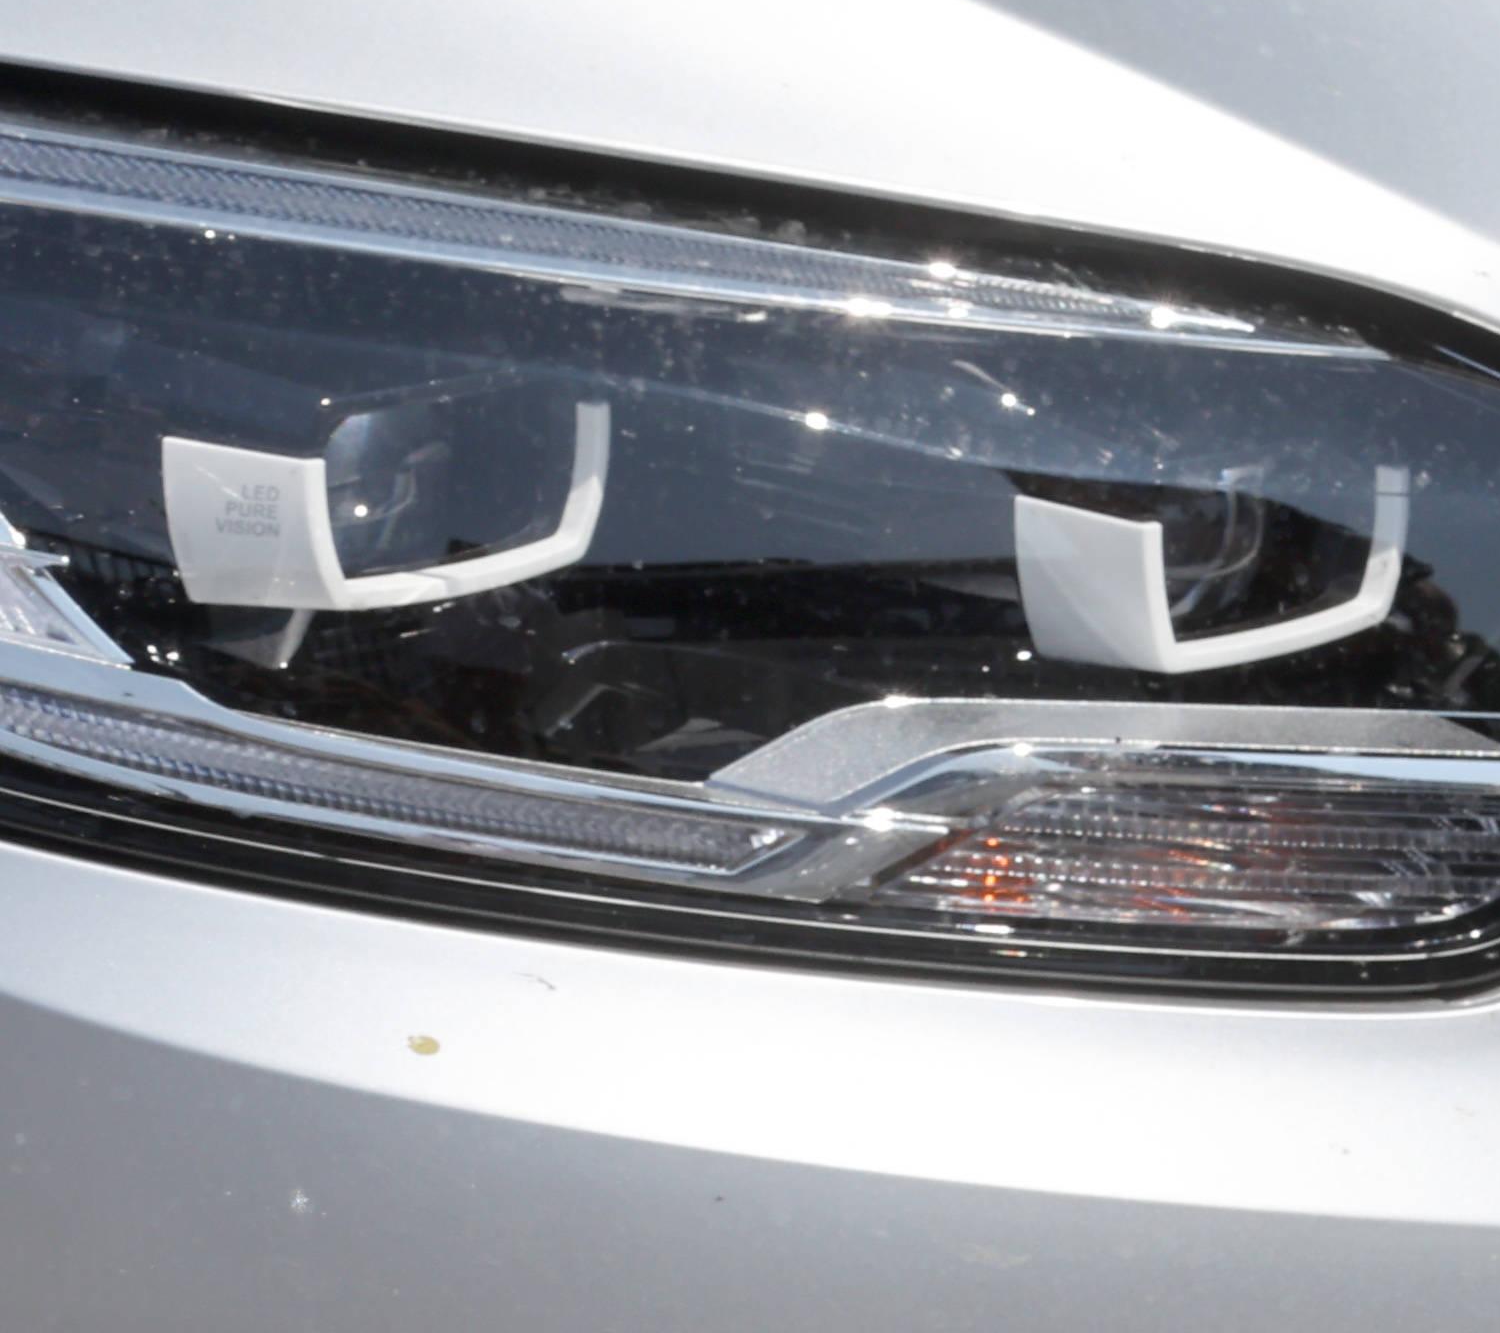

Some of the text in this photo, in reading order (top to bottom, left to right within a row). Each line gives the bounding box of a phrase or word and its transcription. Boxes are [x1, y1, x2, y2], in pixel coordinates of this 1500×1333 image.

[241, 484, 280, 502] LED
[225, 500, 278, 520] PURE
[215, 517, 281, 537] VISION
